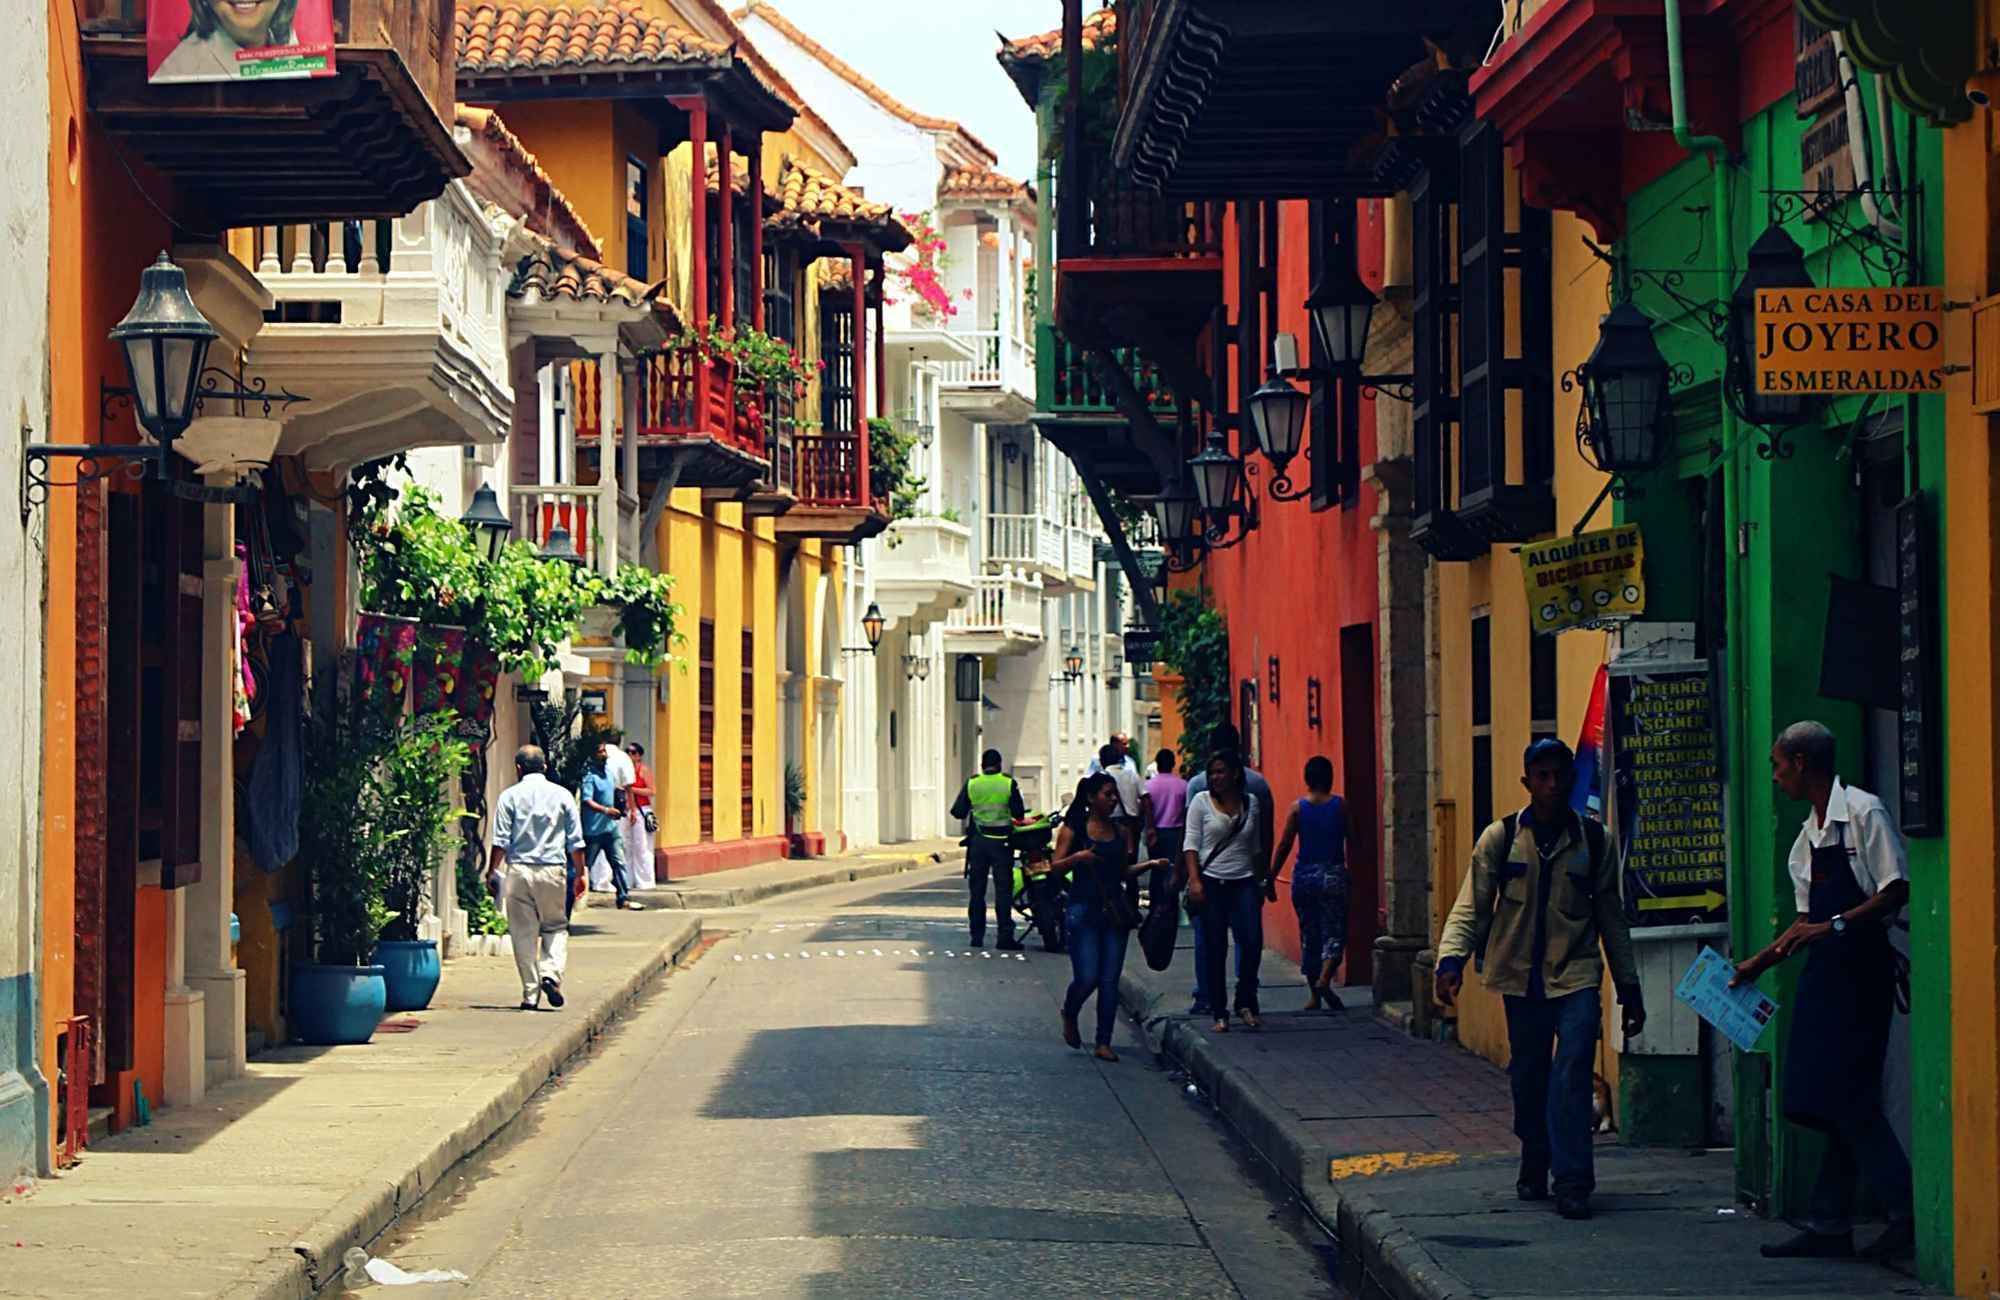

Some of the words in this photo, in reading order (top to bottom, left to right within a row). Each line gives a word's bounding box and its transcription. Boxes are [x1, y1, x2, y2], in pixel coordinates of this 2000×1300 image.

[1760, 294, 1793, 313] LA
[1804, 294, 1873, 313] CASA
[1884, 293, 1938, 312] DEL
[1760, 321, 1939, 360] JOYERO
[1763, 369, 1942, 391] ESMERALDAS
[1529, 538, 1611, 567] ALQUILER
[1616, 531, 1637, 549] DE
[1537, 553, 1635, 587] BICICLETAS
[1629, 855, 1648, 869] DE
[1659, 867, 1724, 884] TABLETS
